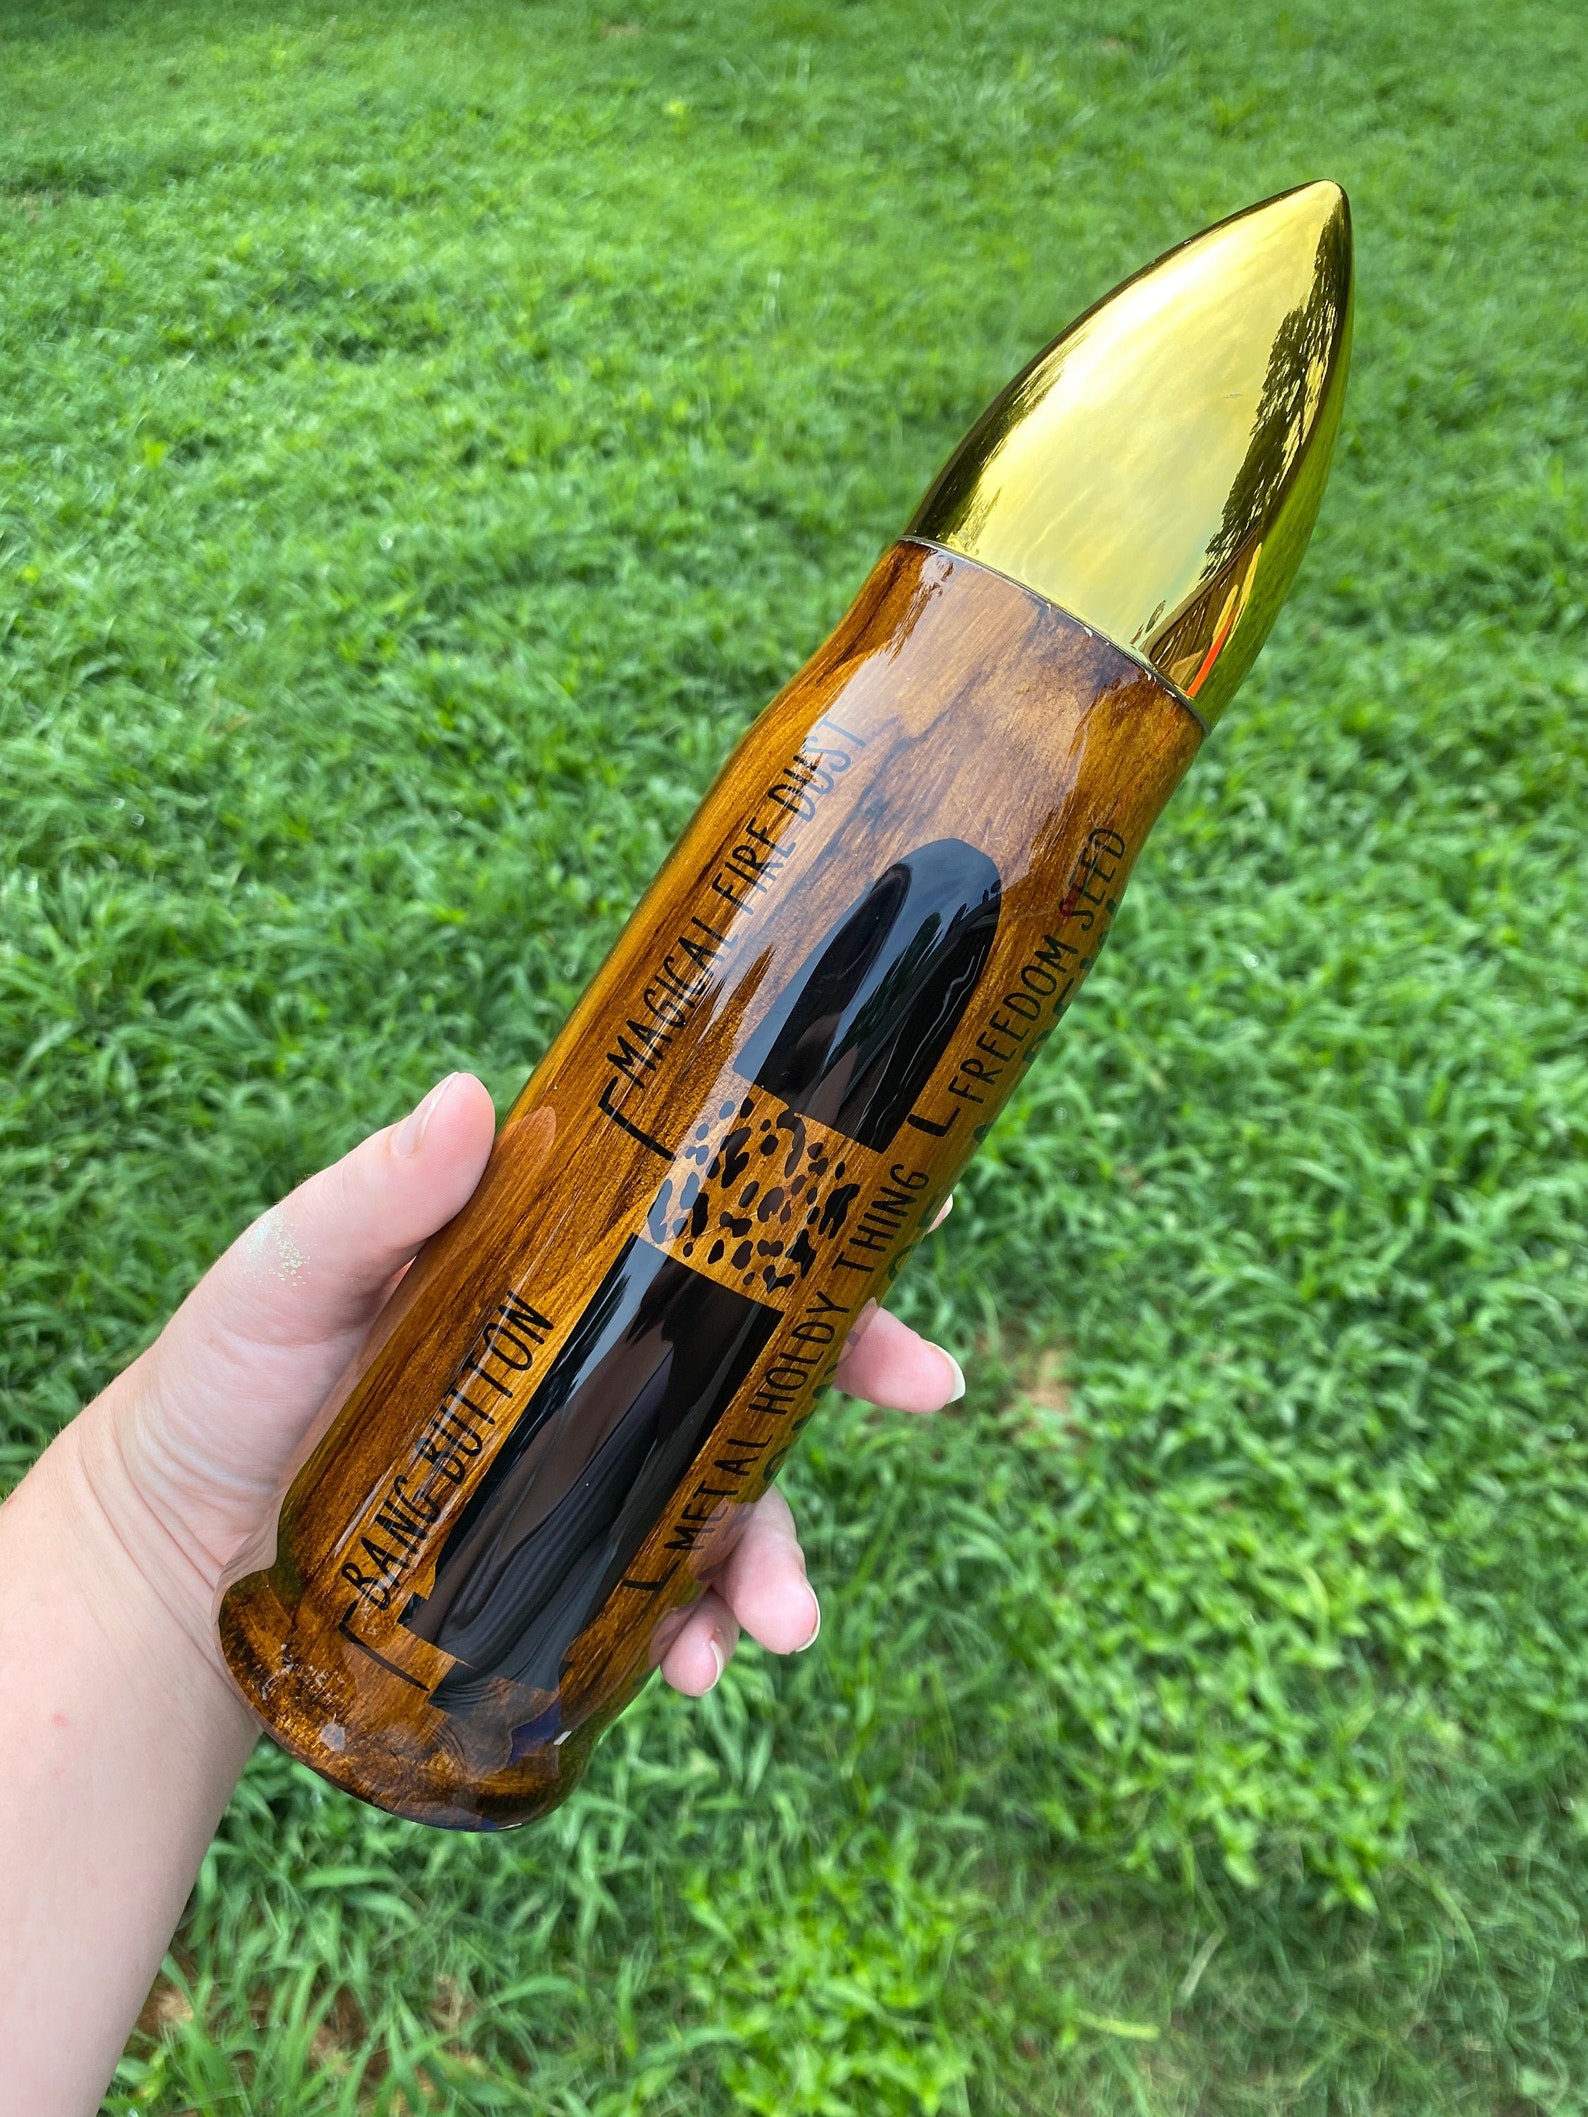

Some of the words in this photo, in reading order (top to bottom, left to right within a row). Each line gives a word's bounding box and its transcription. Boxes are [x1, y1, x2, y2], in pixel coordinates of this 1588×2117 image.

[607, 915, 738, 1087] MAGICAL
[711, 816, 795, 915] FIRE
[767, 713, 866, 822] DUST
[948, 934, 1078, 1104] FREEDOM
[1059, 827, 1126, 931] SEED
[341, 1474, 441, 1611] BANG
[414, 1289, 555, 1486] BUTTON
[664, 1432, 773, 1554] METAL
[748, 1290, 850, 1416] HOLDY
[832, 1163, 931, 1274] THING
